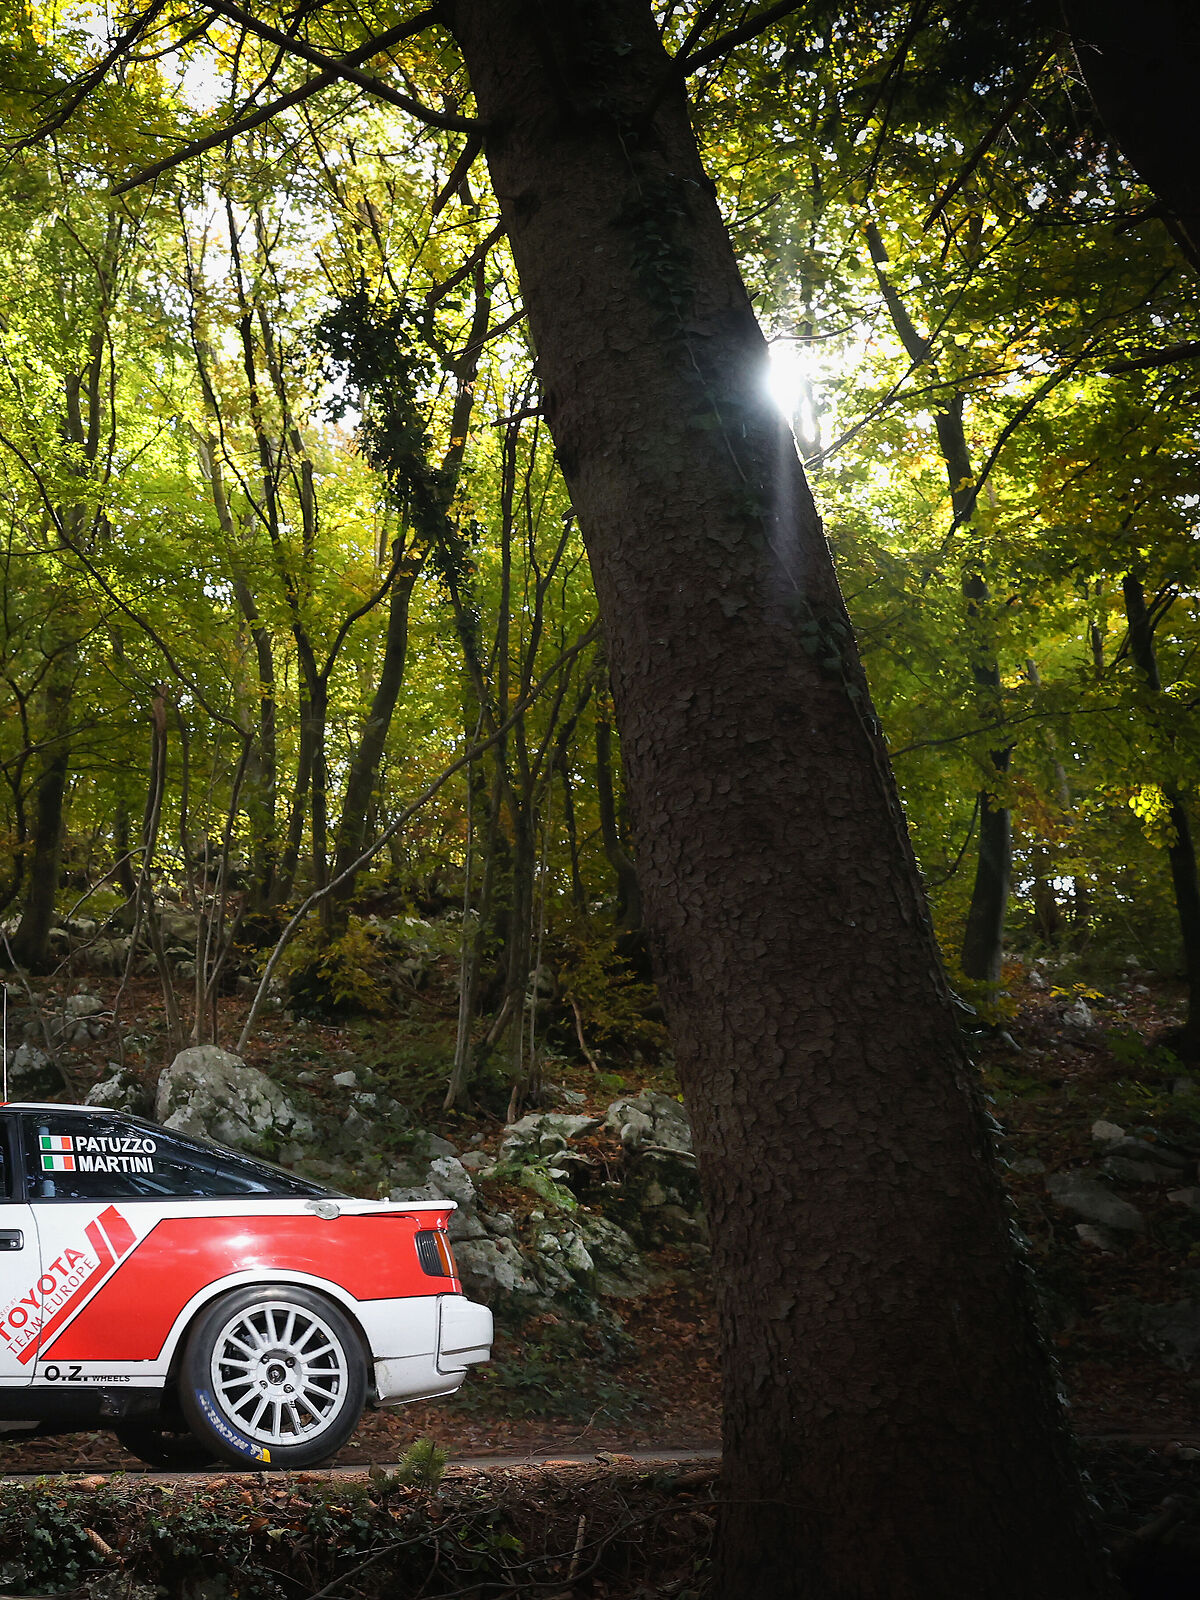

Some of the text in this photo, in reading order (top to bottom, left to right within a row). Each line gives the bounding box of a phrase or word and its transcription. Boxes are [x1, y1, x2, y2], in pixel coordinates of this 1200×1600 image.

[75, 1136, 157, 1154] PATUZZO
[78, 1155, 154, 1173] MARTINI
[6, 1258, 96, 1354] TEAM EUROPE
[44, 1365, 88, 1382] O.Z.
